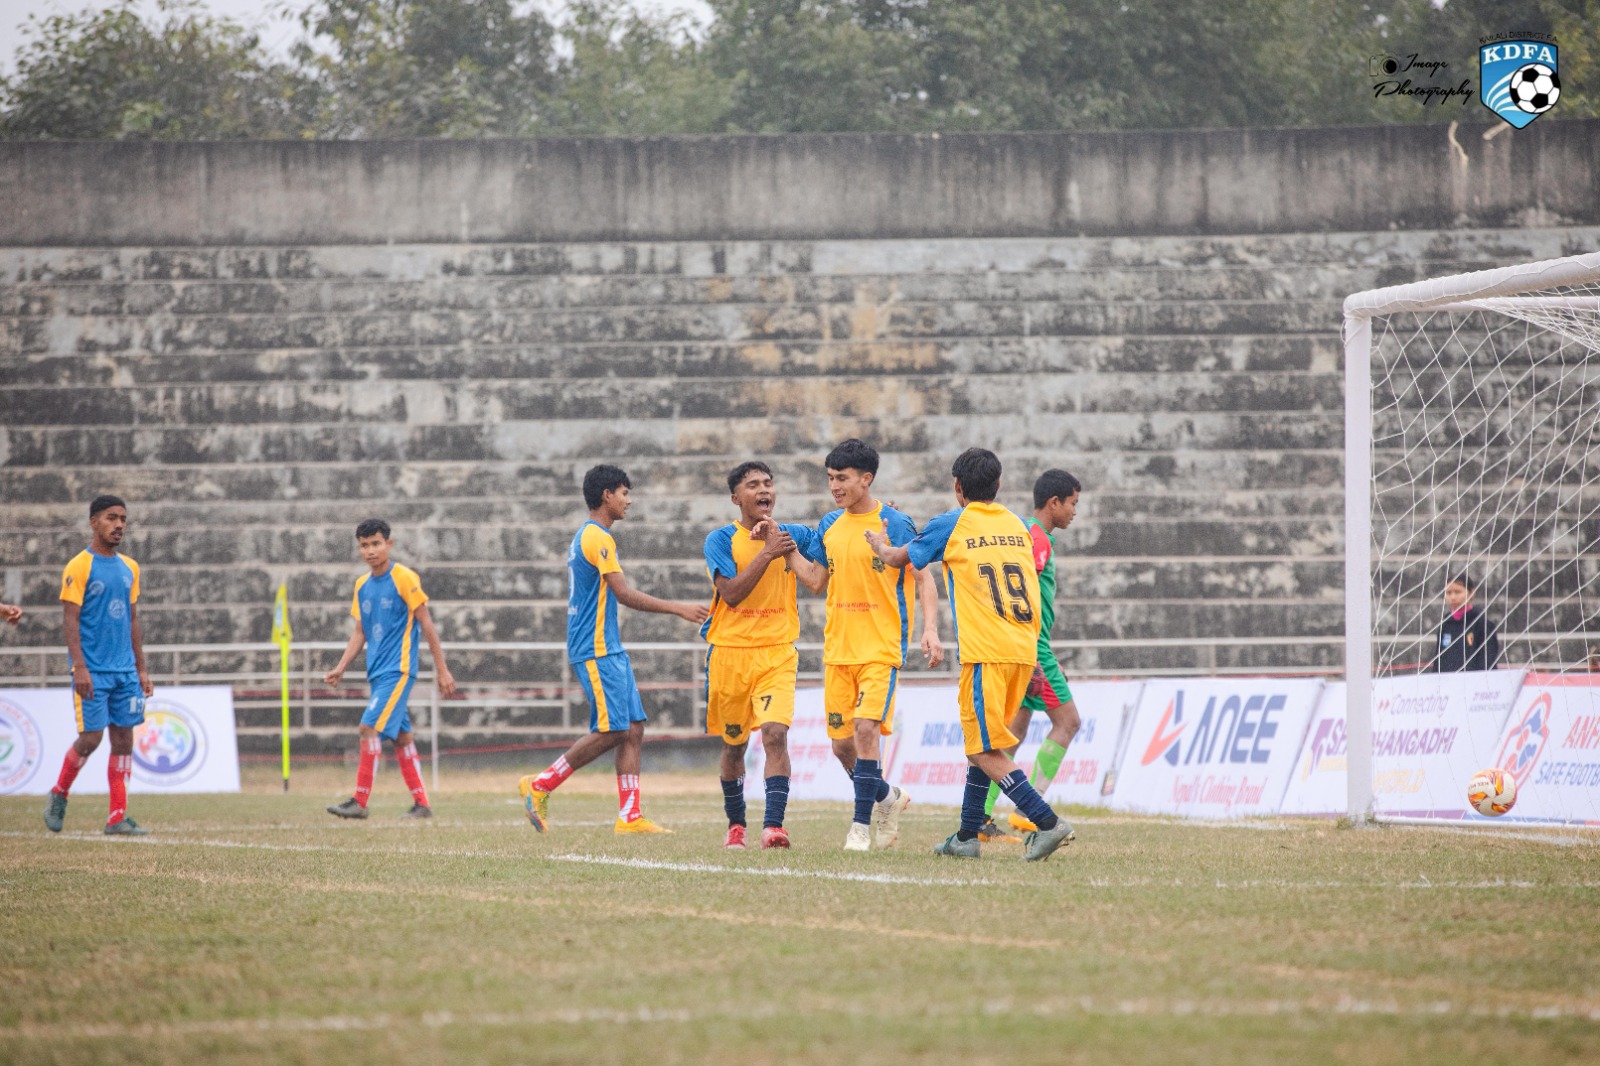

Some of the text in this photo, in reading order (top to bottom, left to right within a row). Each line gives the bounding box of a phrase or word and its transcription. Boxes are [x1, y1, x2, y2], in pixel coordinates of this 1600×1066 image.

[965, 535, 1025, 549] RAJESH
[978, 562, 1034, 624] 19
[760, 695, 772, 711] 7
[1390, 694, 1450, 719] Connecting
[1535, 761, 1568, 786] SAFE
